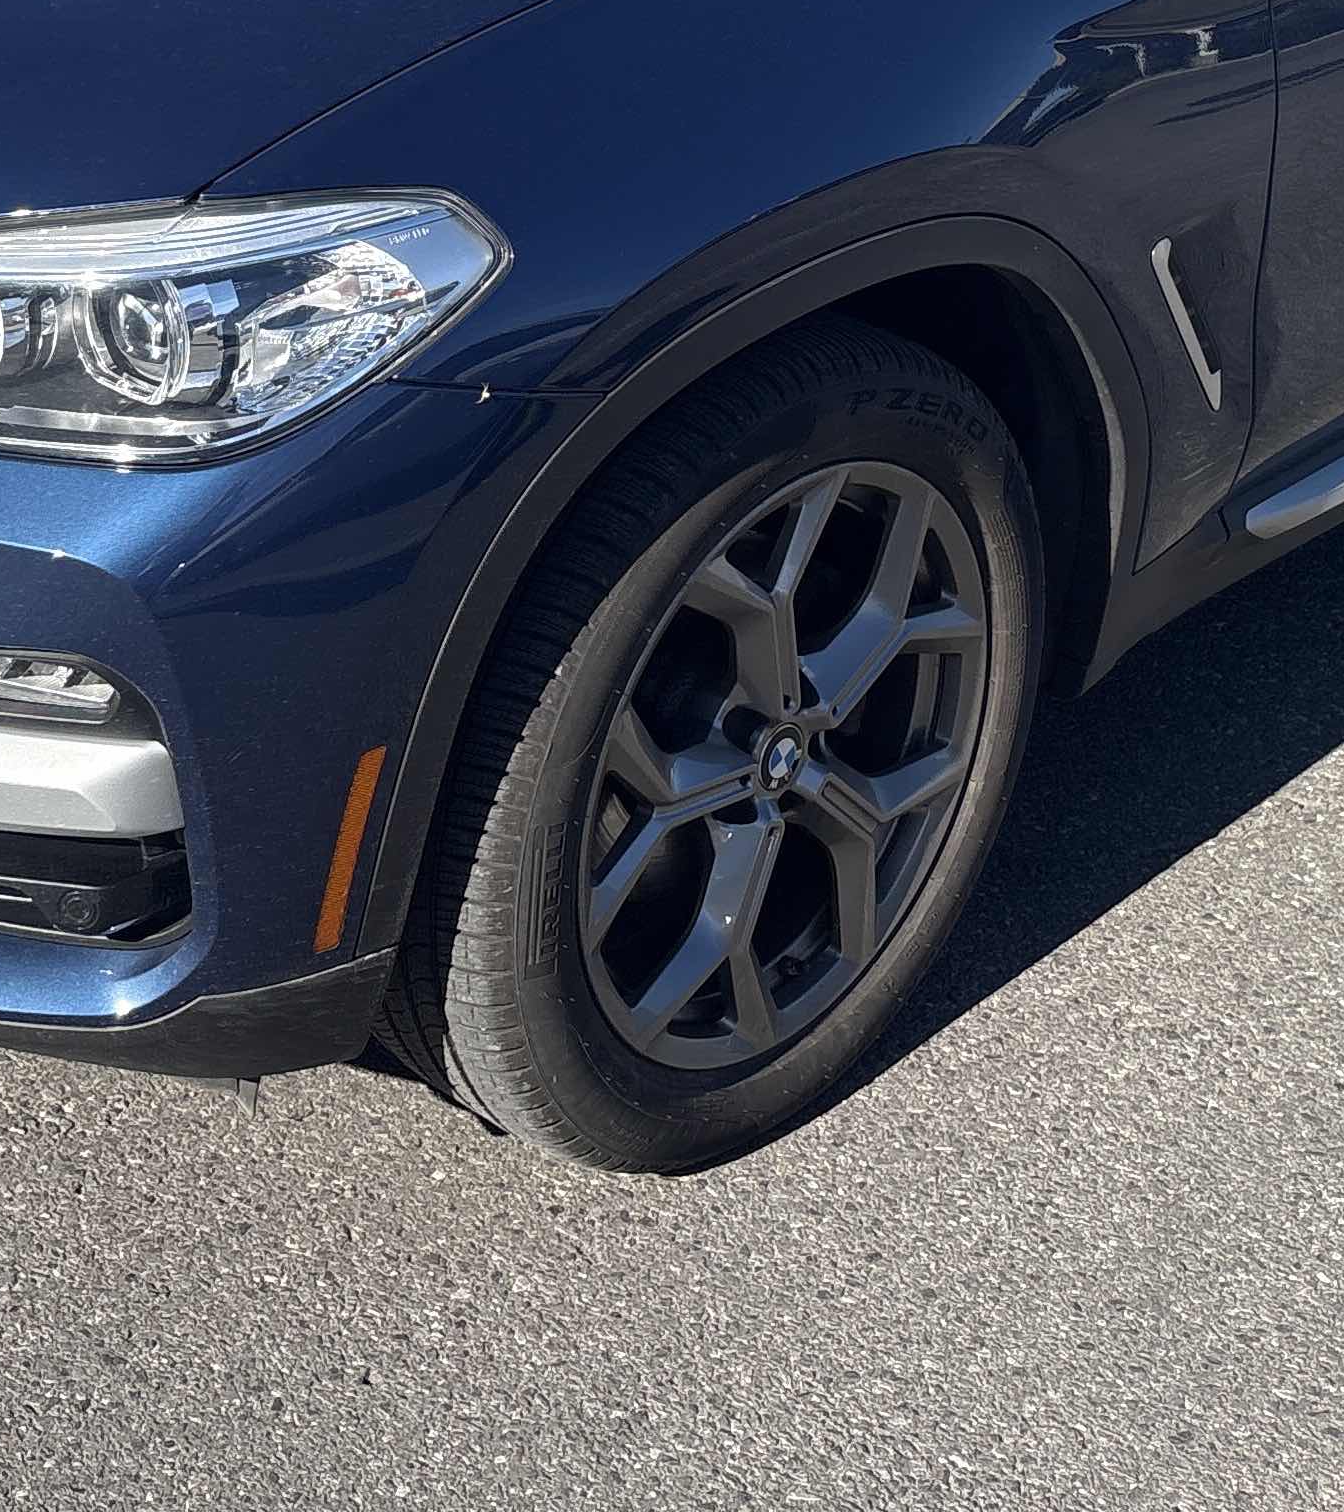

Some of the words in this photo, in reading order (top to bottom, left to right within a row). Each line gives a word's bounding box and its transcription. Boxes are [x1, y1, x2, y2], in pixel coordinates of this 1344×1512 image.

[847, 389, 877, 416] P
[883, 387, 989, 441] ZERO
[524, 823, 568, 980] PIRELLI
